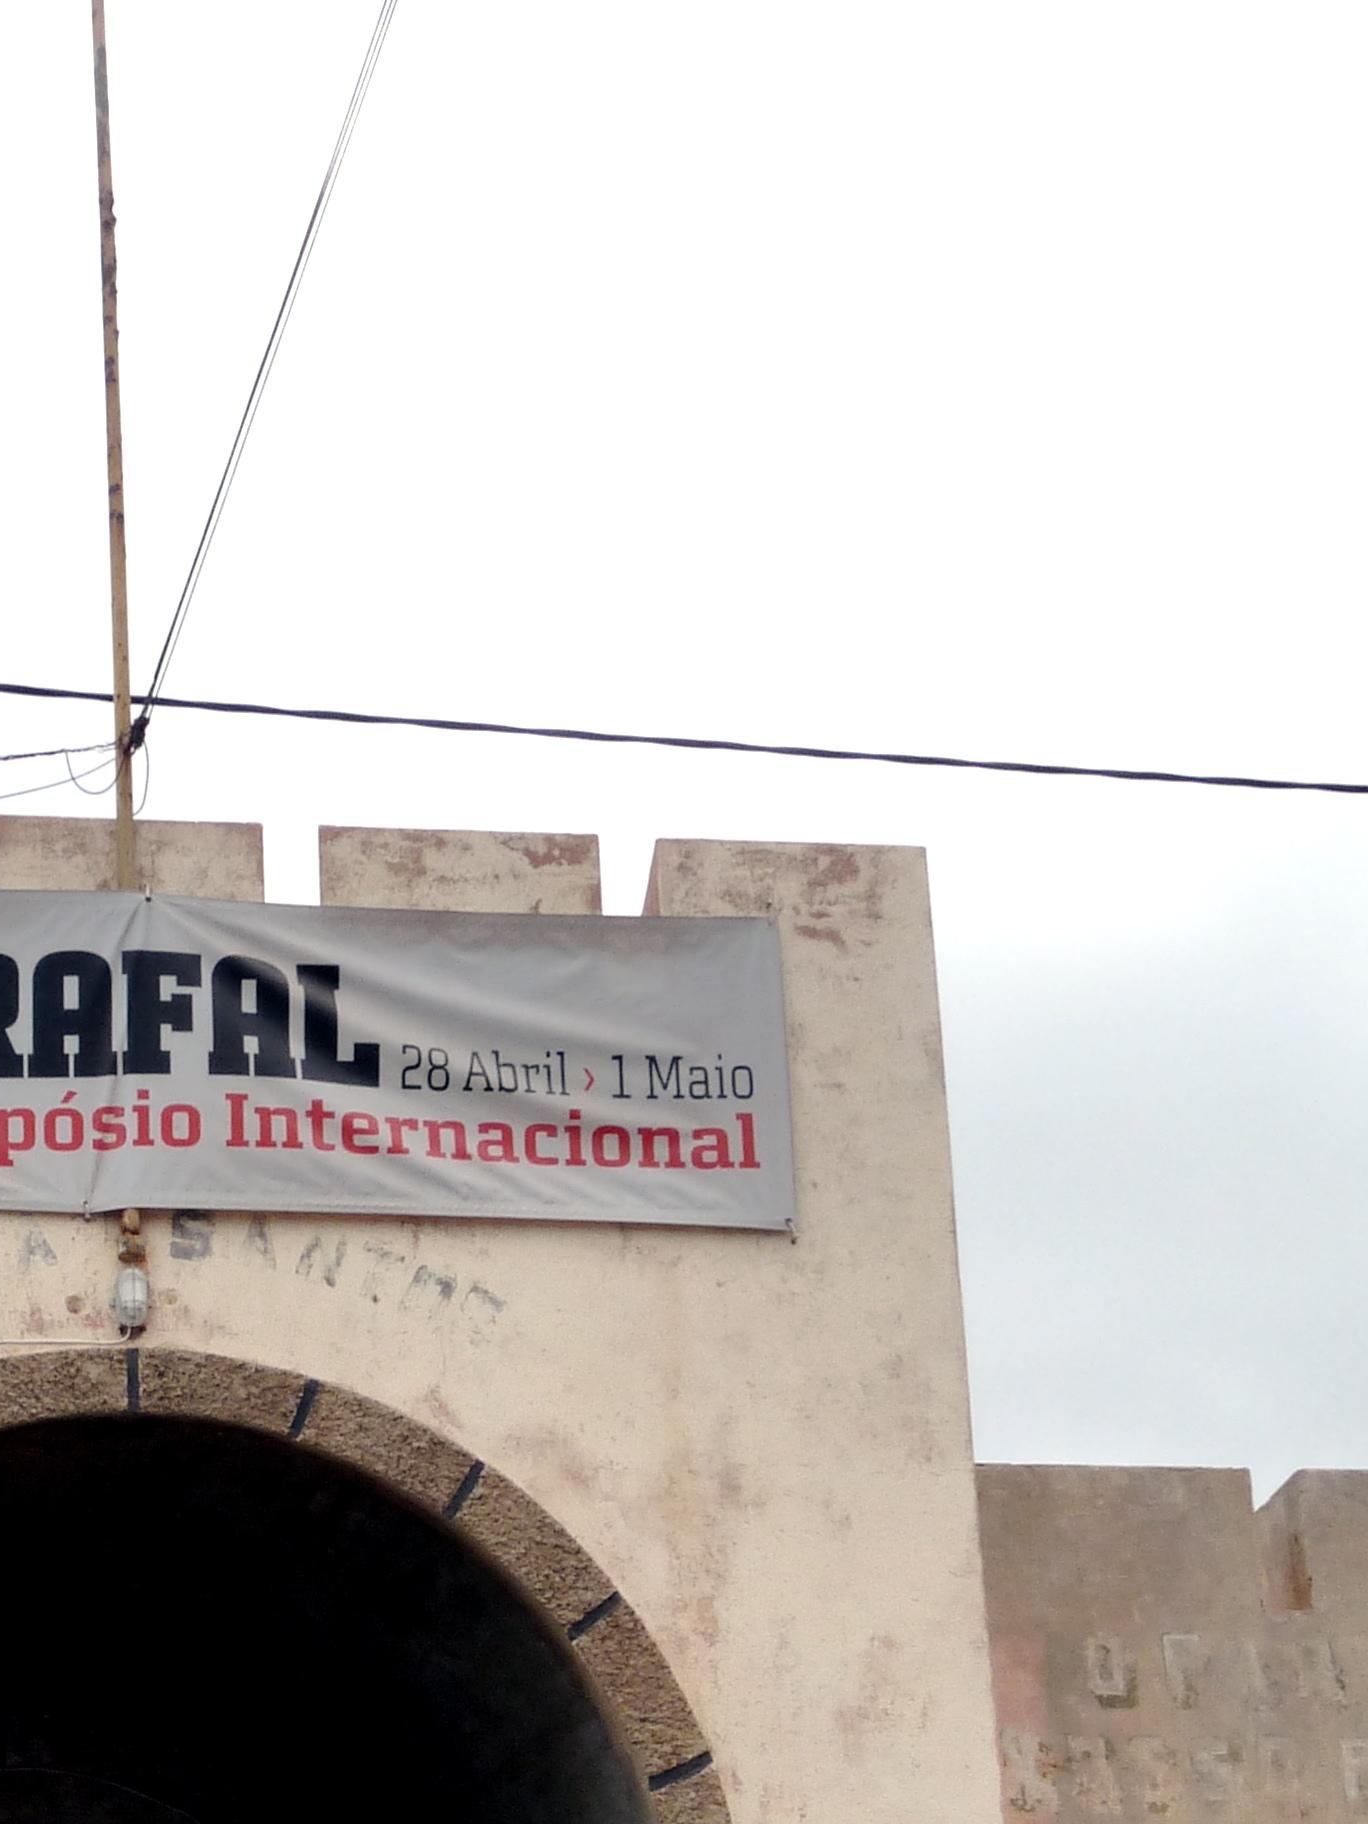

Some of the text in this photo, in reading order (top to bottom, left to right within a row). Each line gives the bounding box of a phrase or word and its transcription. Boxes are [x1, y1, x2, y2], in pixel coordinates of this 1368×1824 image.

[401, 1044, 755, 1101] 28 Abril 1 Maio
[224, 1091, 761, 1171] Internacional
